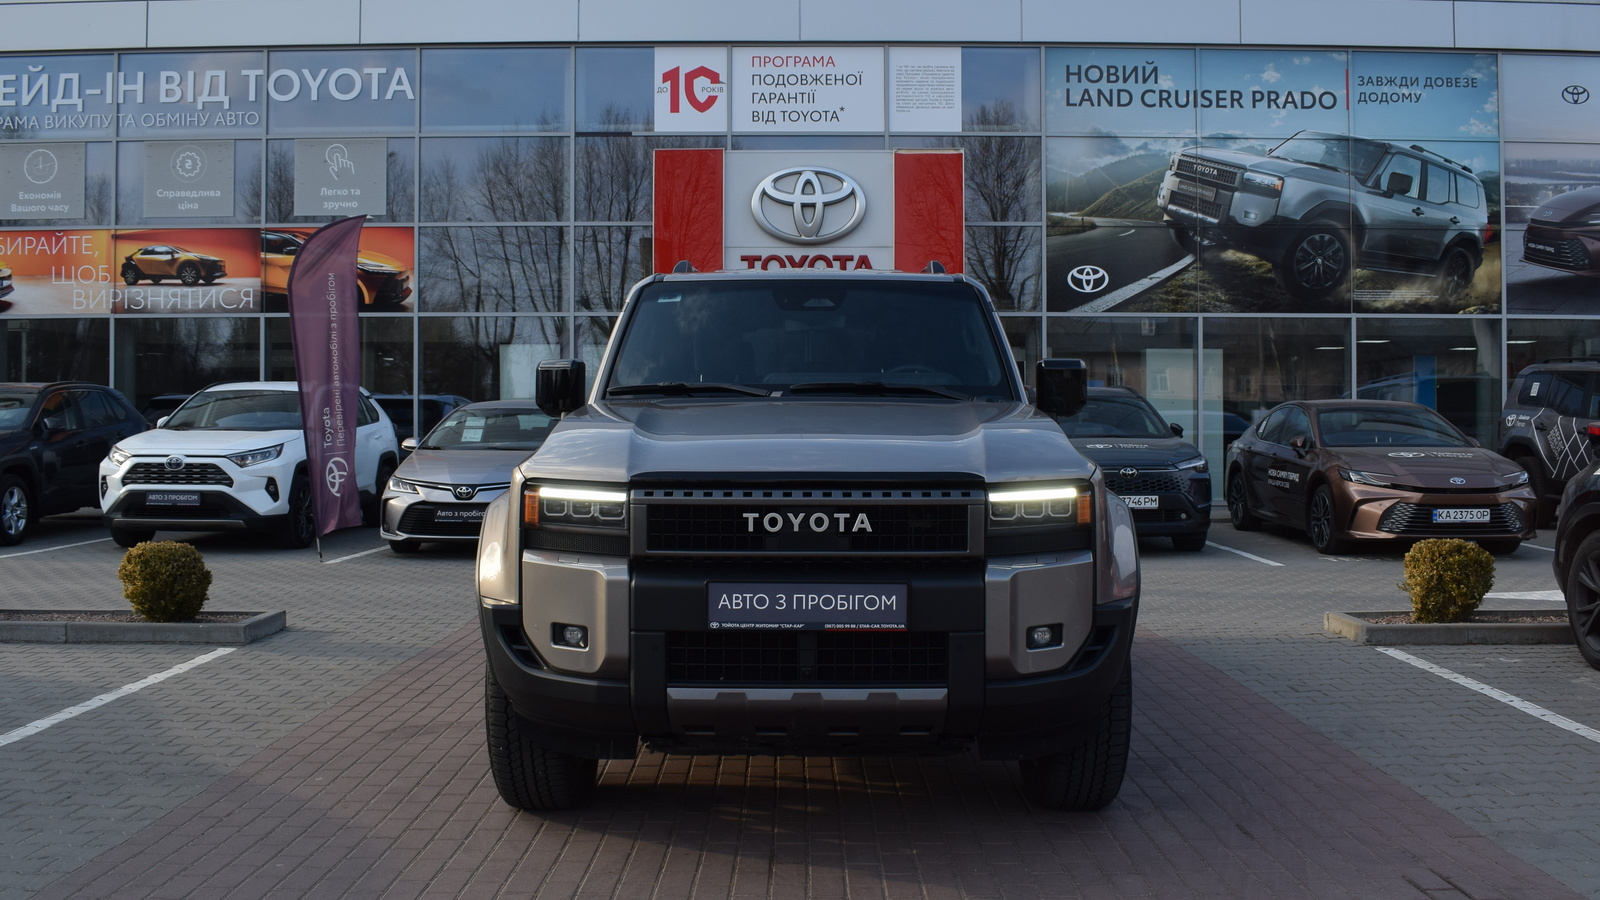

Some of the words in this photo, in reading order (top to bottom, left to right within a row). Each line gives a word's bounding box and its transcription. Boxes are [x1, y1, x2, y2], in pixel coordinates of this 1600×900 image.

[751, 56, 836, 68] ПРОГРАМА
[751, 71, 863, 88] ПОДОВЖЕНОЇ
[1065, 60, 1159, 84] НОВИЙ
[159, 70, 231, 110] ВІД
[241, 67, 416, 103] TOYOTA
[657, 86, 668, 94] ДО
[1357, 75, 1420, 89] ЗАВЖДИ
[1423, 76, 1478, 90] ДОВЕЗЕ
[751, 89, 816, 105] ГАРАНТІЇ
[1065, 88, 1134, 107] LAND
[1140, 89, 1243, 109] CRUISER
[1252, 90, 1338, 110] PRADO
[1357, 92, 1422, 105] ДОДОМУ
[44, 113, 113, 129] ВИКУПУ
[118, 113, 136, 128] ТА
[140, 112, 211, 127] ОБМІНУ
[214, 111, 260, 126] АВТО
[751, 111, 776, 125] ВІД
[1193, 165, 1218, 175] TOYOTA
[18, 190, 62, 200] Економія
[156, 189, 221, 199] Справедлива
[320, 188, 349, 196] Легко
[351, 188, 361, 196] та
[10, 203, 47, 212] Вашого
[48, 204, 70, 213] часу
[178, 202, 199, 211] ціна
[323, 200, 358, 210] зручно
[740, 254, 874, 271] TOYOTA
[51, 265, 111, 288] ЩОБ
[73, 287, 254, 311] ВИРІЗНЯТИСЯ
[326, 272, 338, 321] пробігом
[329, 331, 341, 387] автомобілі
[333, 389, 346, 447] Перевірені
[322, 407, 334, 449] Toyota
[743, 513, 873, 532] TOYOTA
[1437, 510, 1451, 520] KA
[1453, 510, 1475, 520] 2375
[1475, 510, 1489, 520] OP
[718, 593, 769, 610] АВТО
[775, 593, 787, 610] З
[793, 594, 896, 611] ПРОБІГОМ
